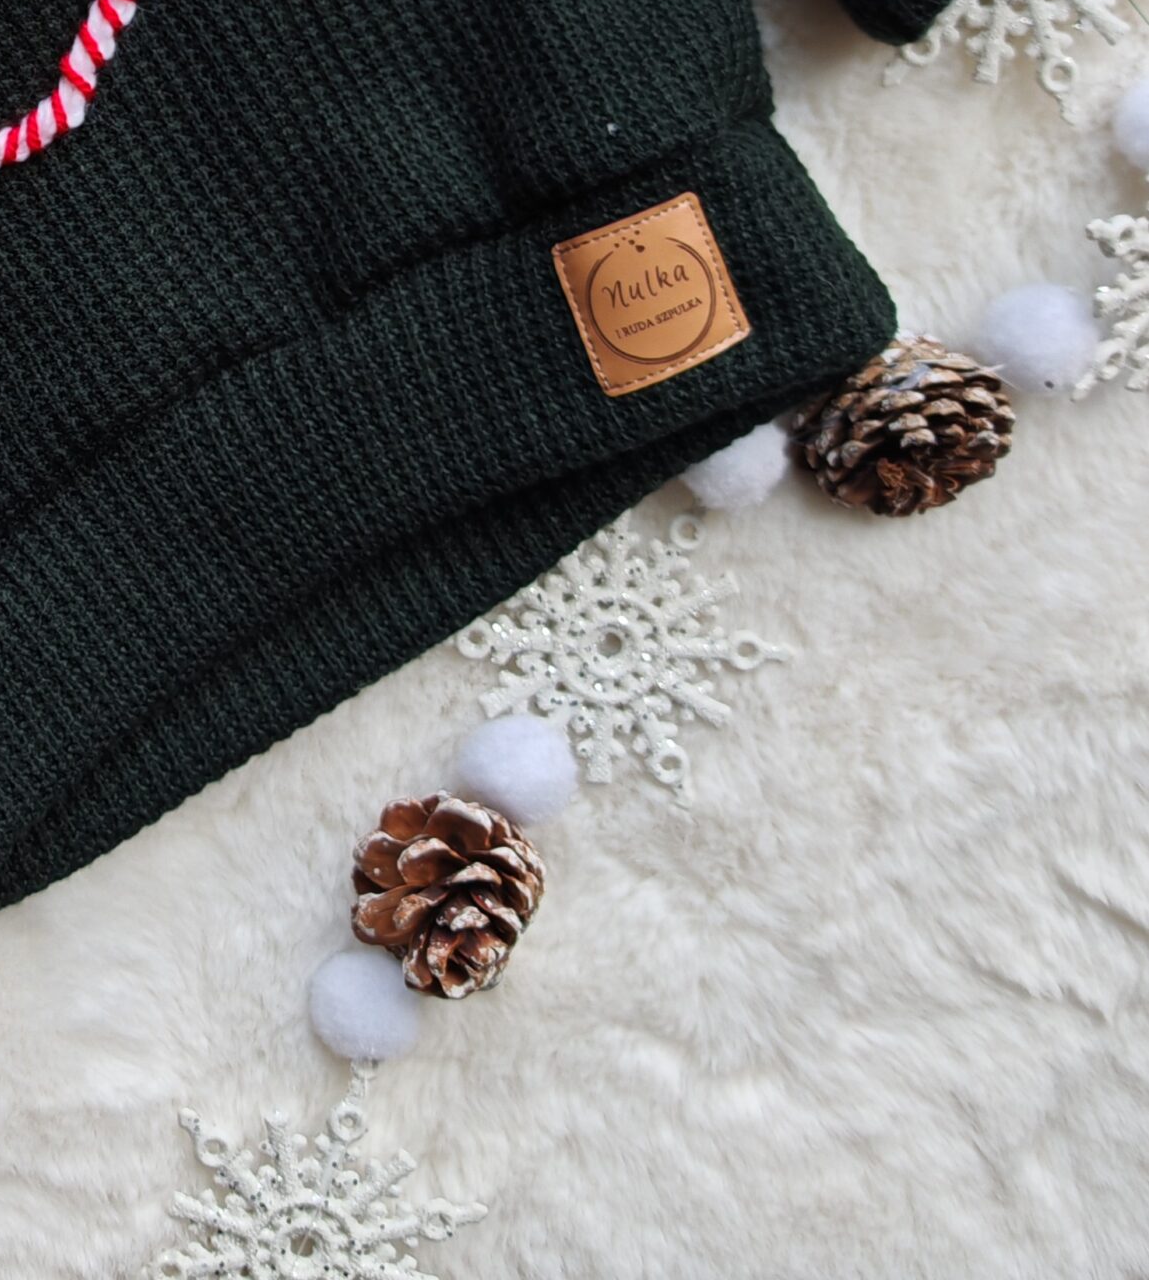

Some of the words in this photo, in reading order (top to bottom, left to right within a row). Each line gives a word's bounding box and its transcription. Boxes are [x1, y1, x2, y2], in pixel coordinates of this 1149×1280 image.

[602, 264, 690, 308] Nulka
[622, 319, 655, 337] RUDA
[655, 297, 703, 325] SZPULKA
